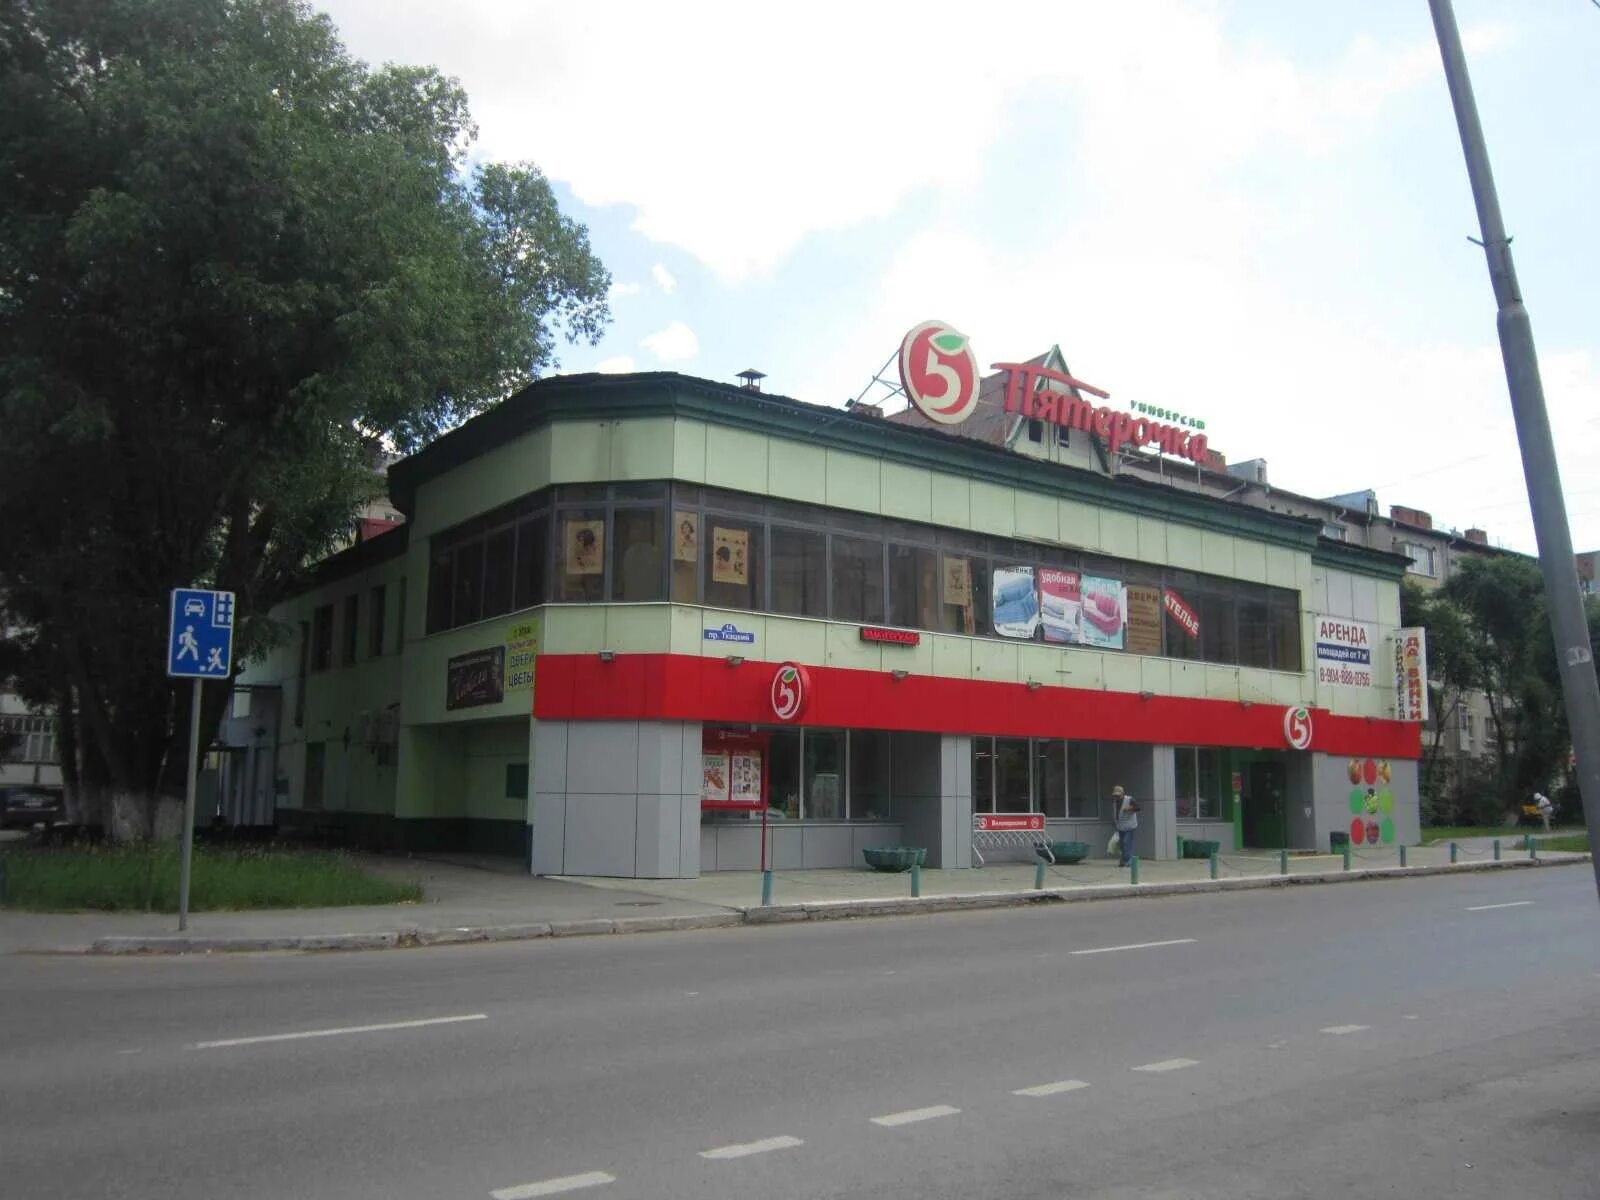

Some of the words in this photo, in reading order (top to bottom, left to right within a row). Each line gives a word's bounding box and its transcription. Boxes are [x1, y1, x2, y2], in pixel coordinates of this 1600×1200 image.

[990, 362, 1208, 463] Пятерочка
[1041, 572, 1076, 585] удобная
[1164, 593, 1199, 635] АТЕЛЬЕ
[1320, 621, 1367, 646] АРЕНДА
[509, 671, 534, 688] ЦВЕТЫ
